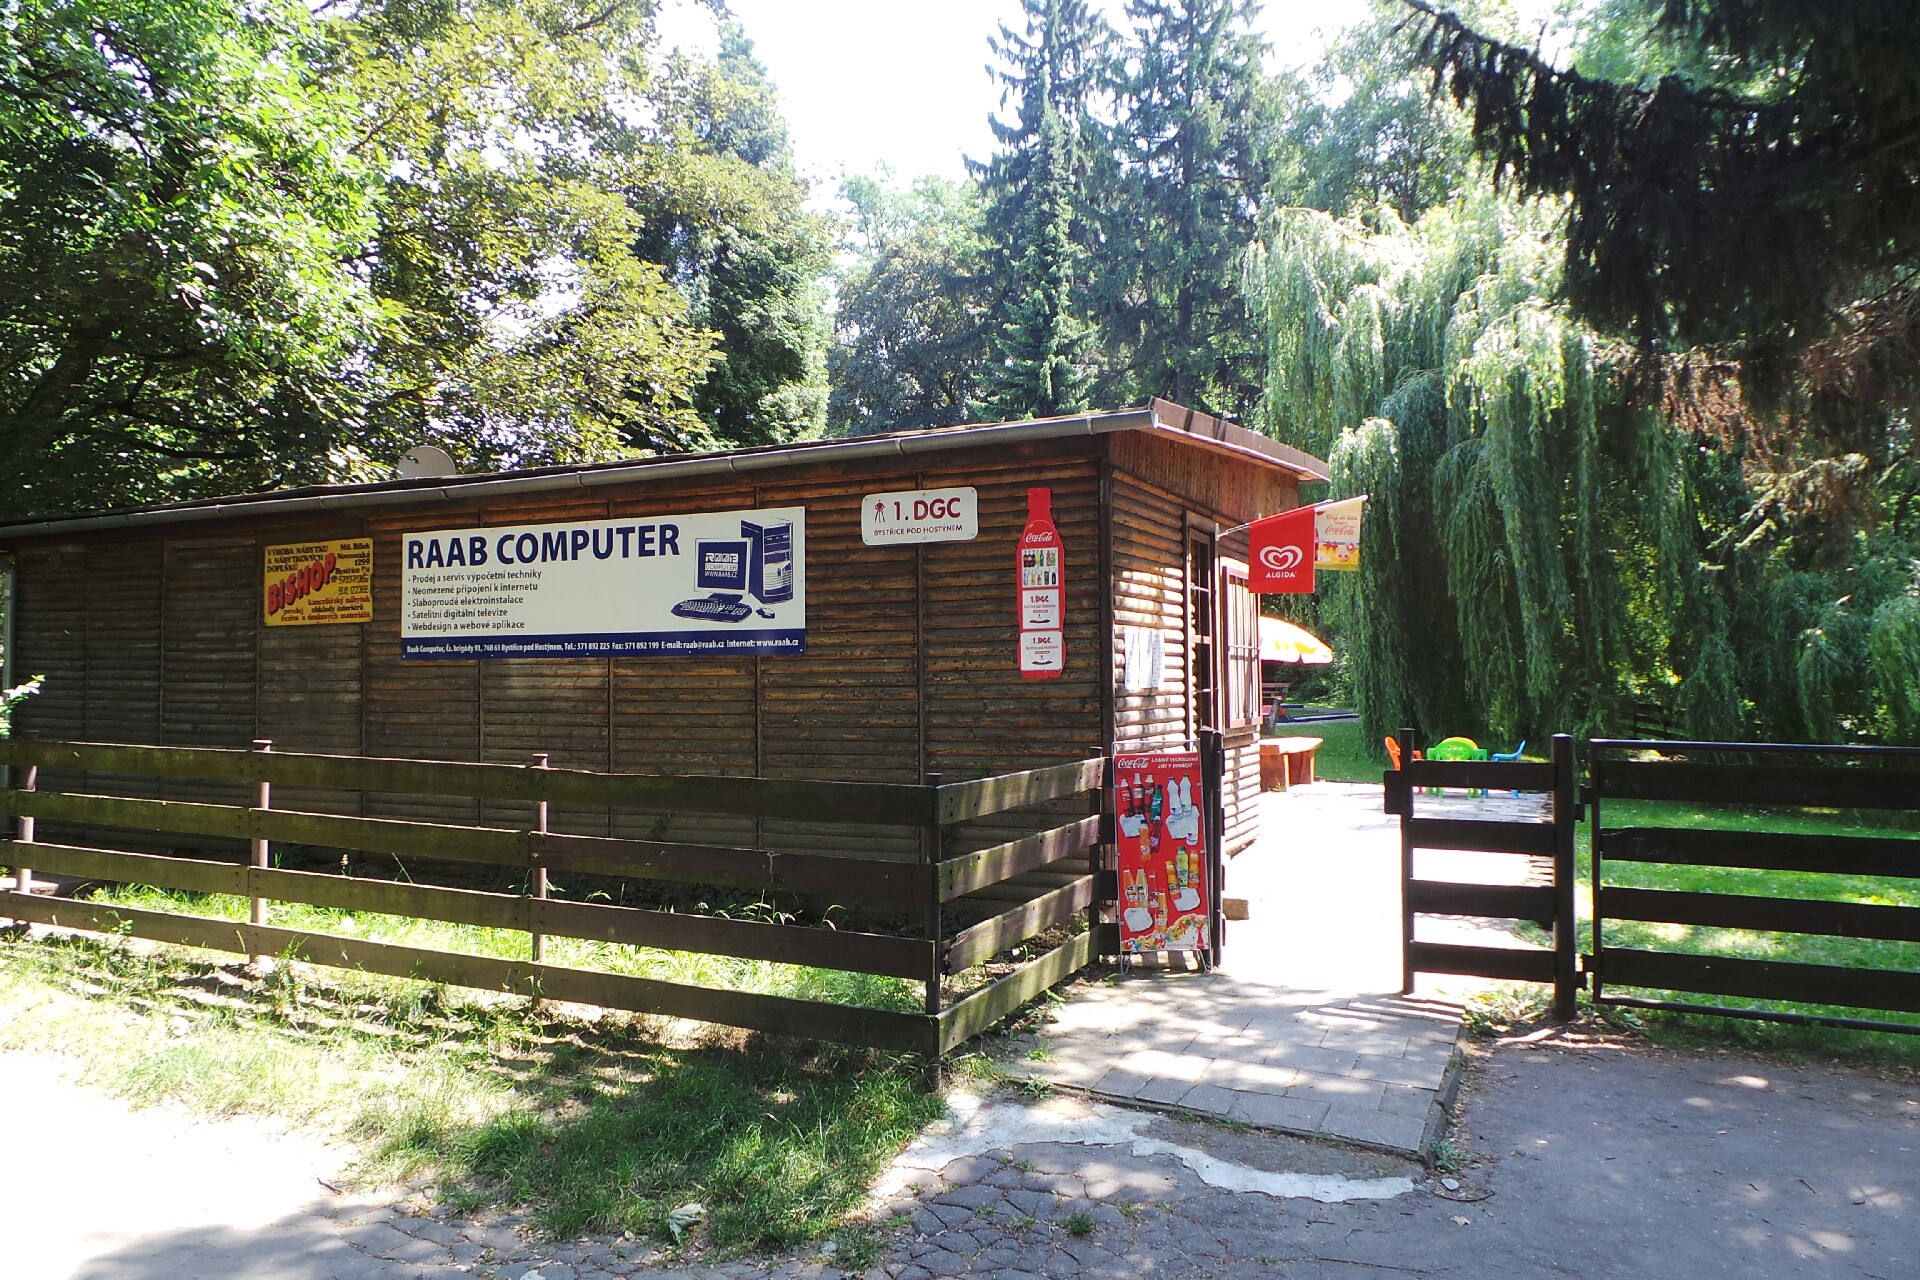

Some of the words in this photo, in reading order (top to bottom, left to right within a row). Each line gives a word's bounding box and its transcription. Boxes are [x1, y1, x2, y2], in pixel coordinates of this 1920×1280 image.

[874, 527, 905, 536] BYSTŘICE
[923, 524, 963, 533] HOSTÝNEM
[1026, 531, 1053, 543] Coca-Cola
[408, 536, 488, 569] RAAB
[496, 523, 680, 565] COMPUTER
[705, 563, 738, 571] COMPUTER
[412, 574, 436, 584] Prodej
[443, 573, 465, 582] servis
[467, 571, 505, 582] výpočetní
[507, 569, 542, 580] techniky
[268, 553, 336, 616] BISHOP
[412, 585, 454, 595] Neomezené
[456, 583, 493, 594] připojení
[494, 583, 499, 591] k
[500, 582, 538, 591] internetu
[412, 597, 459, 608] Slaboproudé
[460, 595, 524, 605] elektroinstalace
[412, 609, 442, 619] Satelitní
[443, 608, 476, 619] digitální
[477, 607, 508, 617] televize
[412, 622, 452, 632] Webdesign
[460, 620, 490, 629] webové
[492, 620, 525, 630] aplikace
[407, 645, 419, 653] Raab
[420, 645, 445, 654] Computer,
[453, 645, 474, 654] brigády
[501, 643, 523, 653] Bystřice
[523, 643, 534, 652] pod
[535, 643, 564, 652] Hostýnem,
[577, 642, 588, 650] 571
[588, 642, 599, 650] 892
[600, 642, 610, 650] 225
[612, 642, 624, 650] Fax:
[625, 642, 635, 650] 571
[636, 642, 647, 650] 892
[648, 641, 659, 649] 199
[661, 641, 682, 649] E-mail:
[683, 640, 724, 649] raab@raab.cz
[727, 640, 755, 648] Internet:
[756, 638, 798, 647] www.raab.cz
[1118, 757, 1150, 768] Coca-Cola
